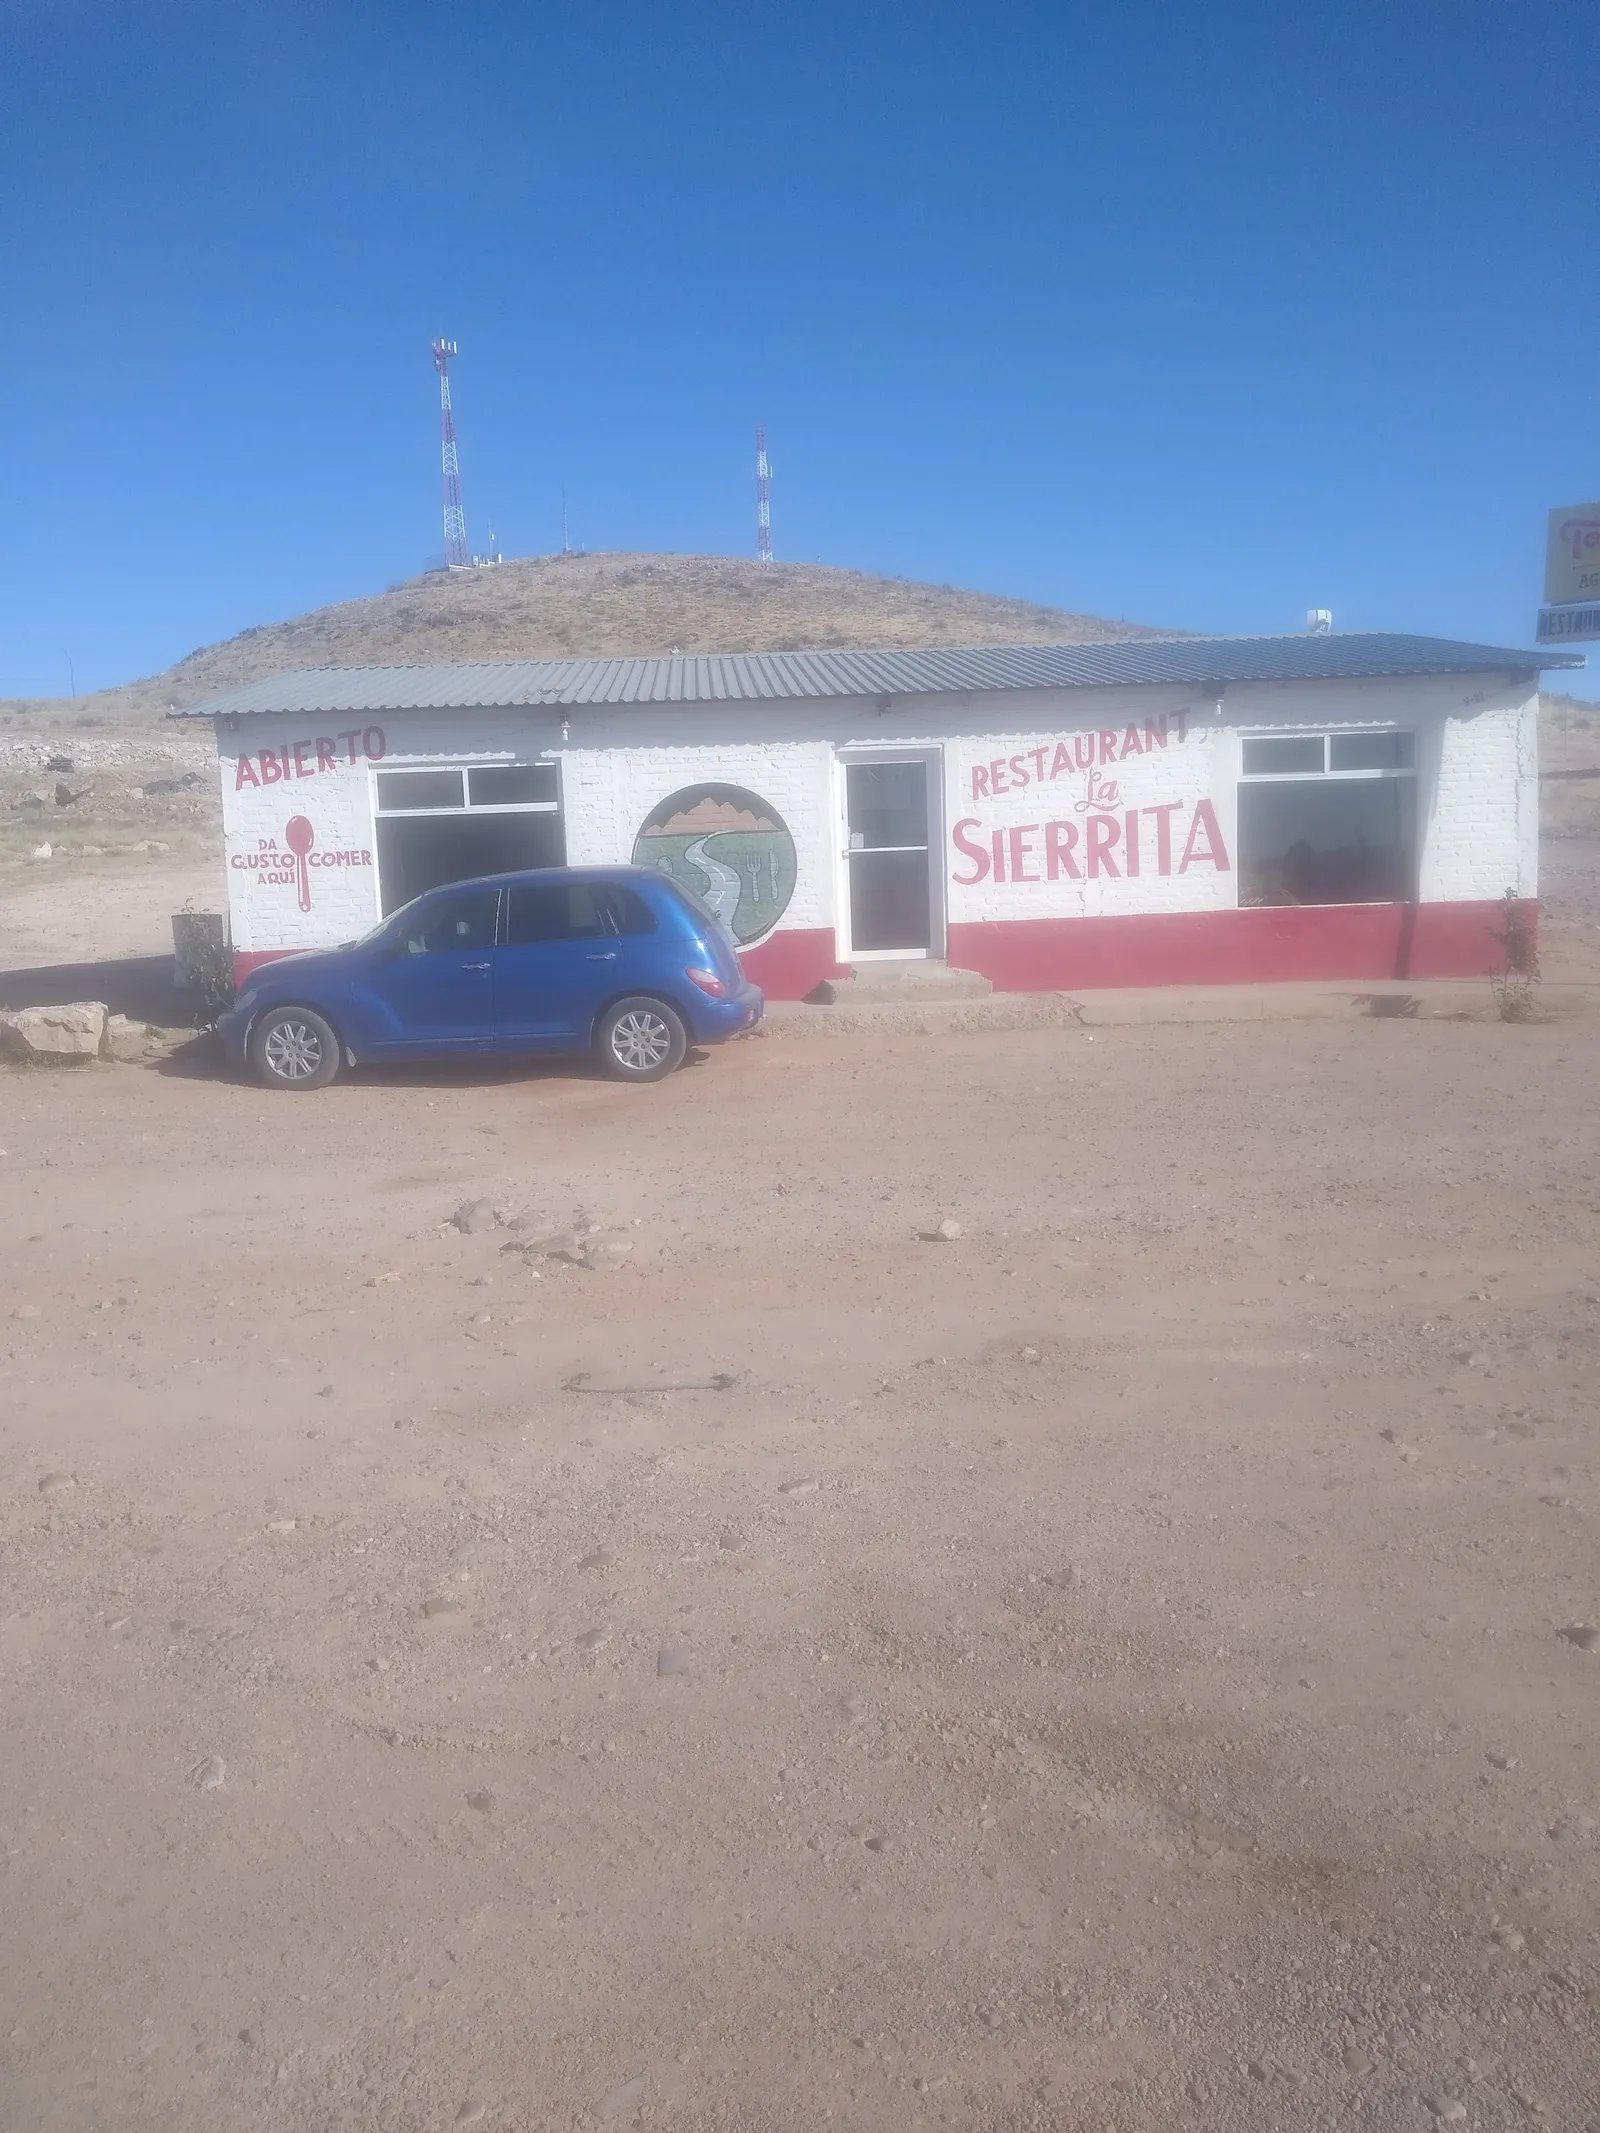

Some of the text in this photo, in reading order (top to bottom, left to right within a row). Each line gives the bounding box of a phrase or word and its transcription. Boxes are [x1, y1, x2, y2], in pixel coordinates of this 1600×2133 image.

[236, 725, 386, 791] ABIERTO
[972, 707, 1191, 801] RESTAURANT
[1074, 768, 1125, 812] La
[231, 850, 373, 870] GUSTO COMER
[258, 838, 278, 851] DA
[952, 798, 1231, 885] SIERRITA
[257, 868, 296, 885] AQUÍ
